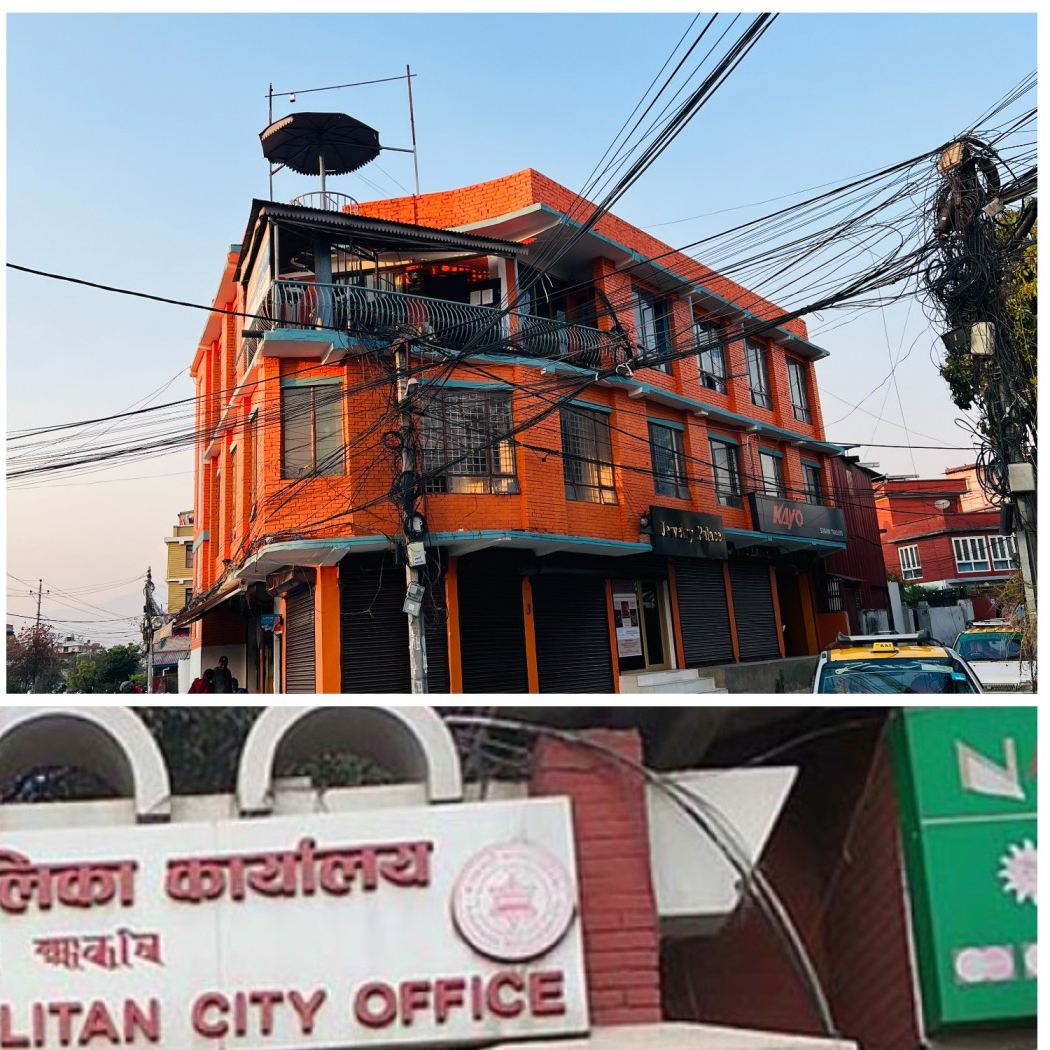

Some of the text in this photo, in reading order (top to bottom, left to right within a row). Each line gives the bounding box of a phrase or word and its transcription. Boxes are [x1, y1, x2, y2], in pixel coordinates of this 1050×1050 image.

[166, 837, 434, 903] कार्यालय
[191, 988, 327, 1039] CITY
[354, 971, 567, 1029] OFFICE
